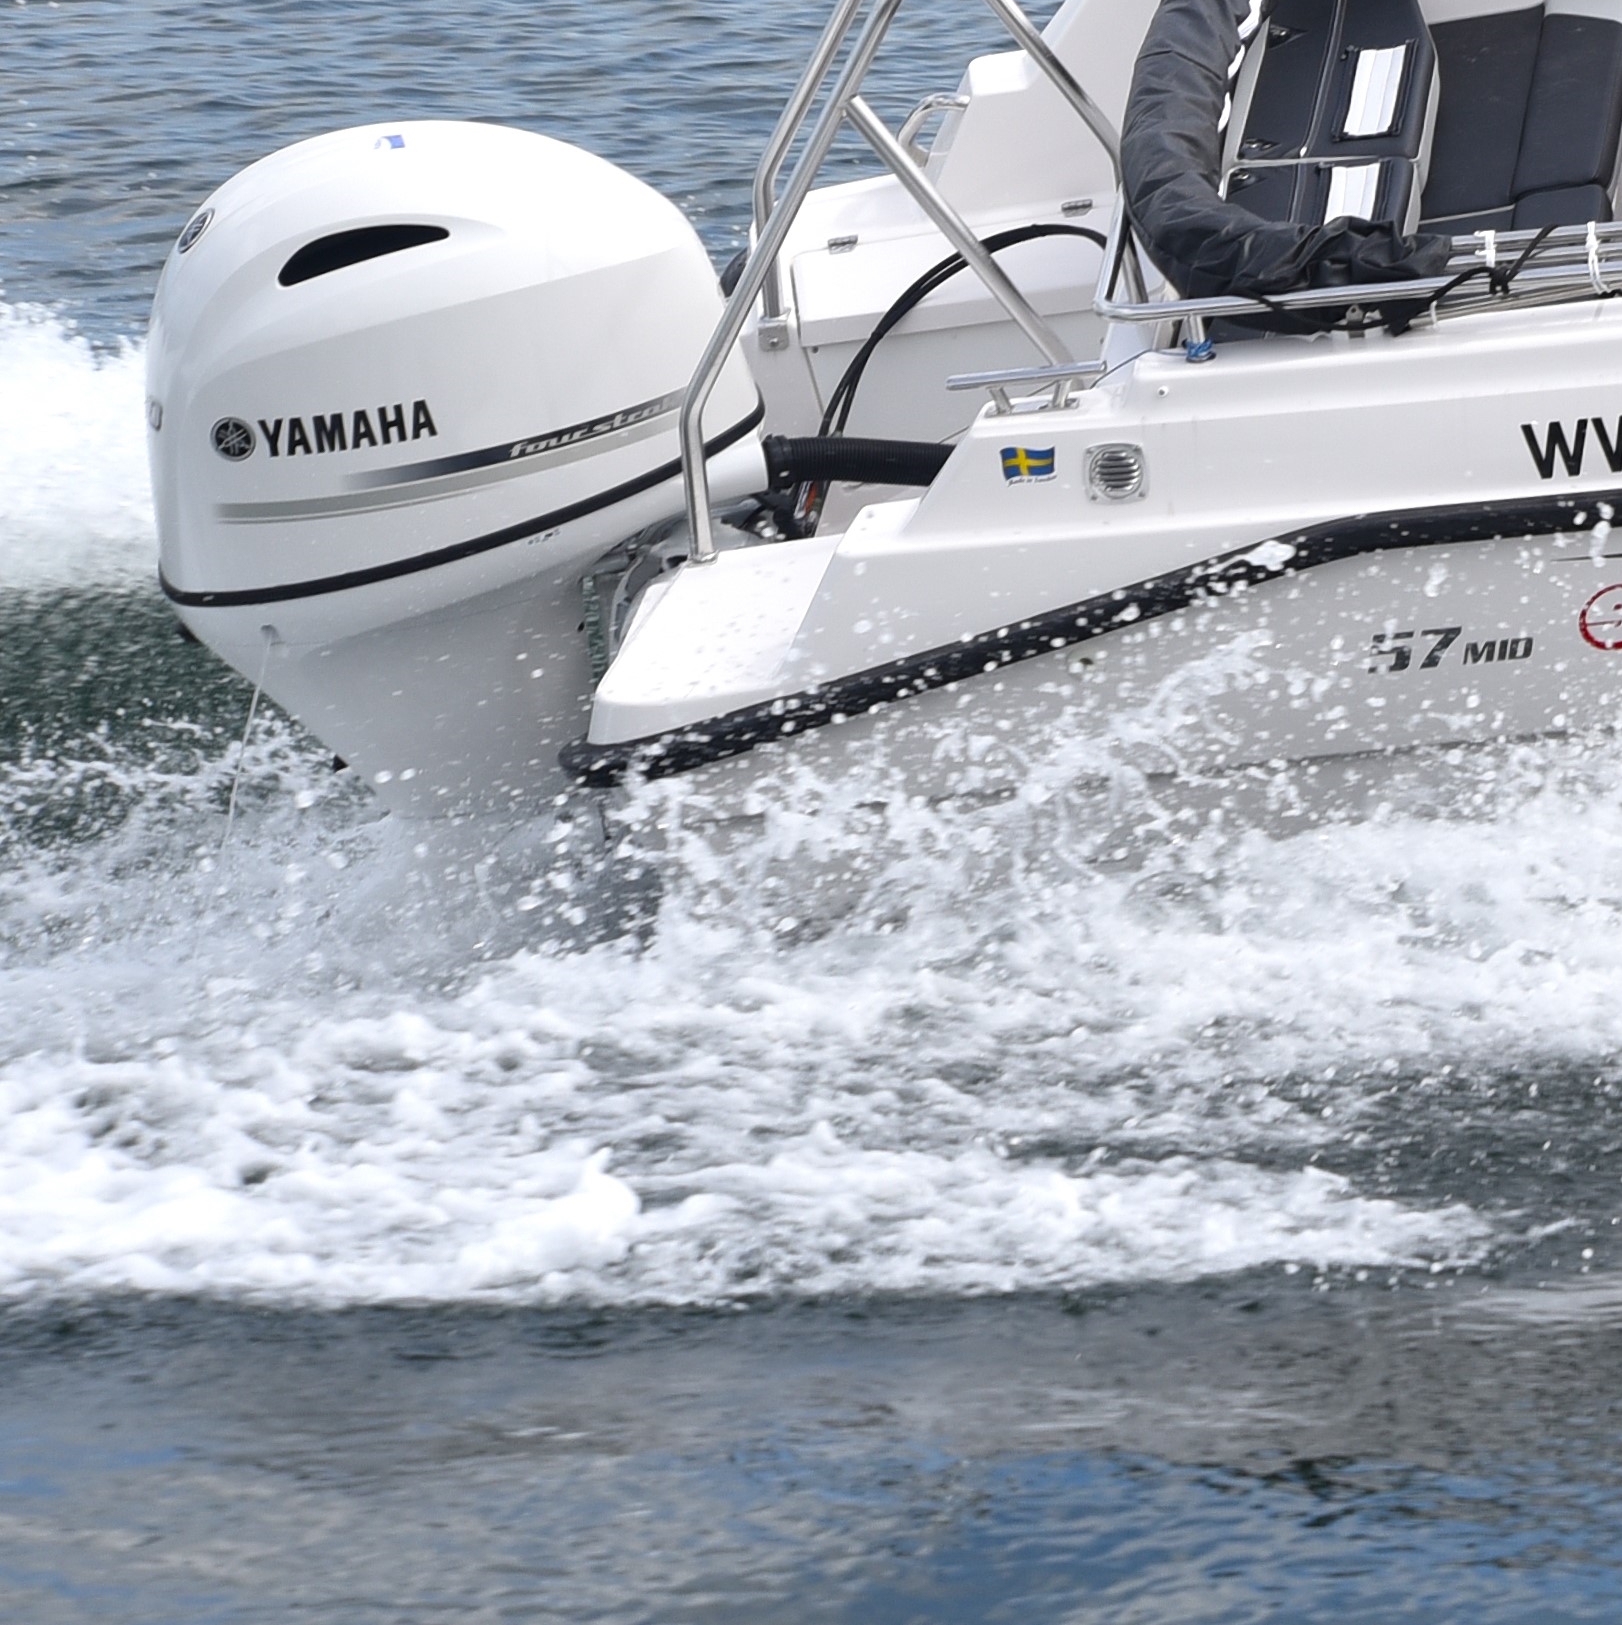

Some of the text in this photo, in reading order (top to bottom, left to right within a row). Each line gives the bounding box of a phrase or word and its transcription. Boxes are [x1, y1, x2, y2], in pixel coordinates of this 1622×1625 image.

[257, 399, 438, 457] YAMAHA
[1368, 626, 1533, 674] 57 MID
